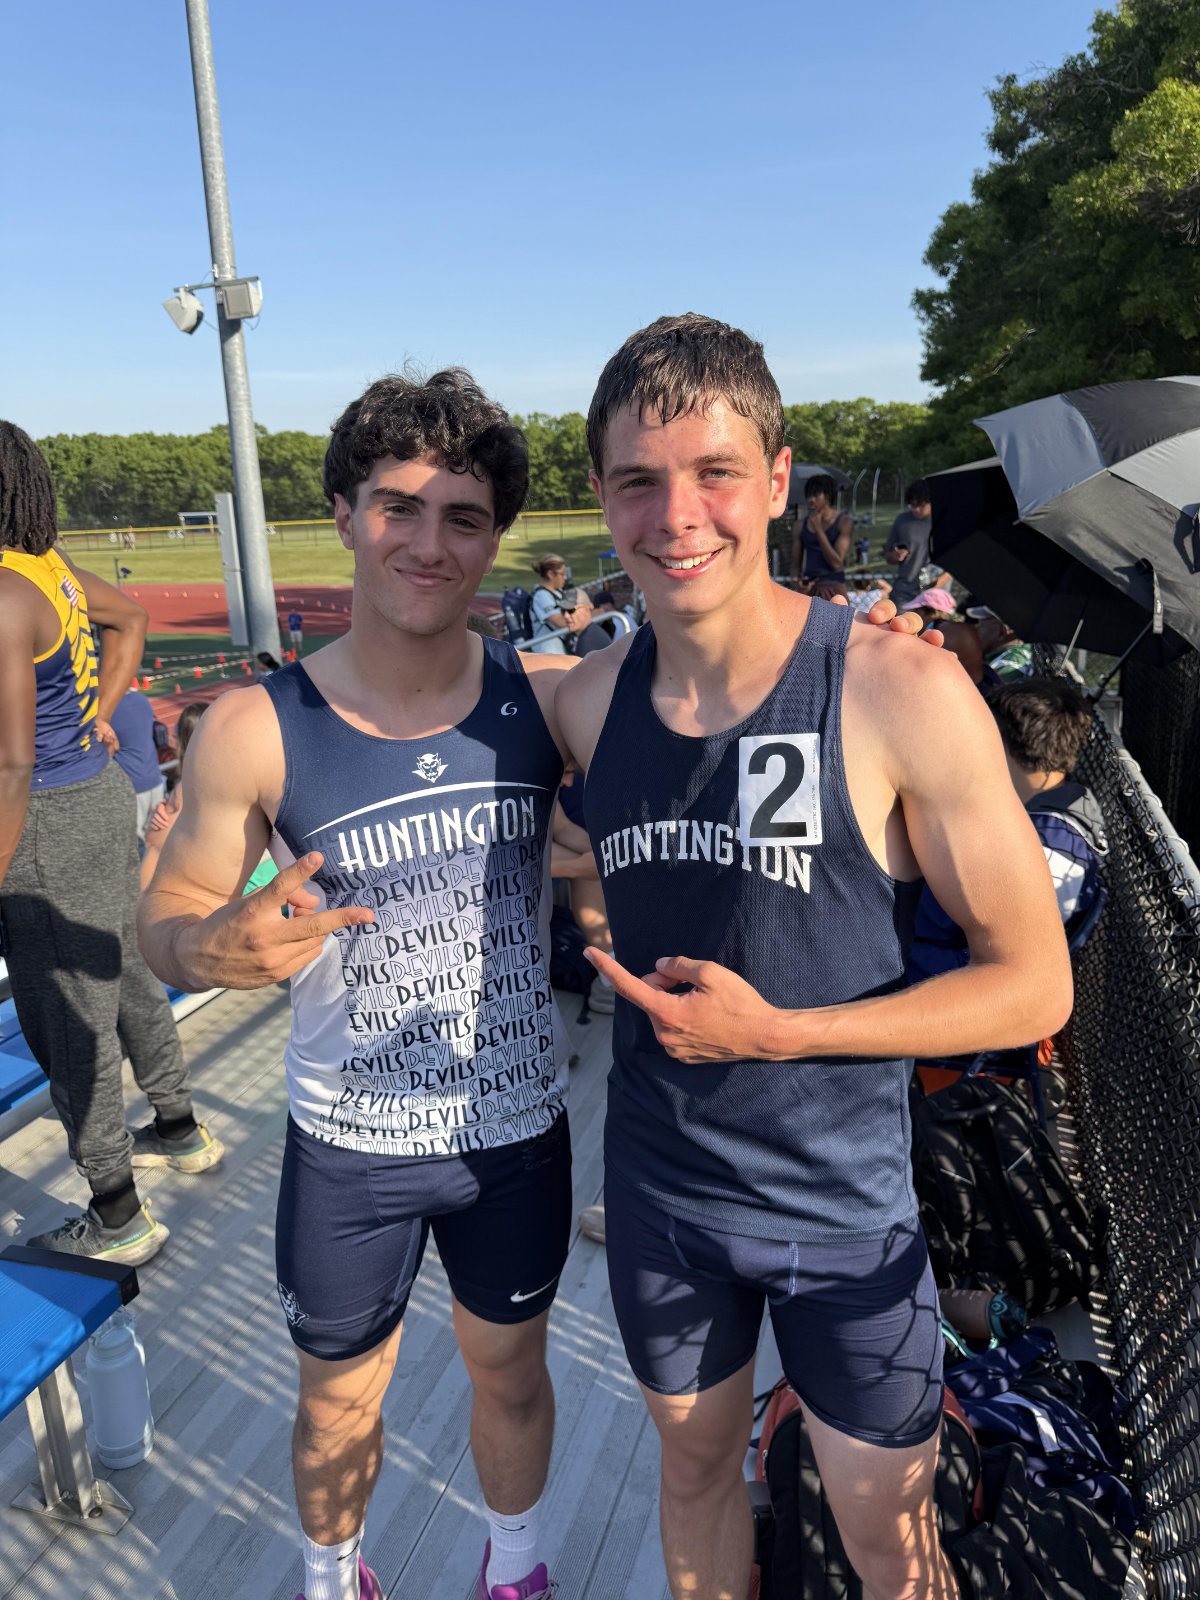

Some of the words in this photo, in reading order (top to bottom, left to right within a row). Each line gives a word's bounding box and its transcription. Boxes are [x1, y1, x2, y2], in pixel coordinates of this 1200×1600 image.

[748, 742, 808, 839] 2
[338, 795, 535, 874] HUNTINGTON
[373, 865, 448, 908] DEVILS
[447, 845, 519, 888] DEVILS
[378, 892, 454, 934] DEVILS
[453, 872, 522, 914] DEVILS
[385, 917, 460, 959] DEVILS
[458, 895, 525, 940] DEVILS
[389, 942, 463, 984] DEVILS
[463, 922, 527, 964] DEVILS
[395, 966, 467, 1006] DEVILS
[466, 945, 531, 988] DEVILS
[401, 991, 471, 1031] DEVILS
[470, 969, 532, 1011] DEVILS
[401, 1014, 472, 1049] DEVILS
[472, 992, 536, 1033] DEVILS
[404, 1036, 474, 1070] DEVILS
[473, 1014, 537, 1053] DEVILS
[339, 1085, 408, 1113] DEVILS
[408, 1079, 479, 1110] DEVILS
[478, 1058, 541, 1097] DEVILS
[409, 1058, 476, 1091] DEVILS
[475, 1036, 538, 1076] DEVILS
[407, 1101, 481, 1131] DEVILS
[480, 1079, 544, 1121] DEVILS
[482, 1106, 551, 1149] DEVILS
